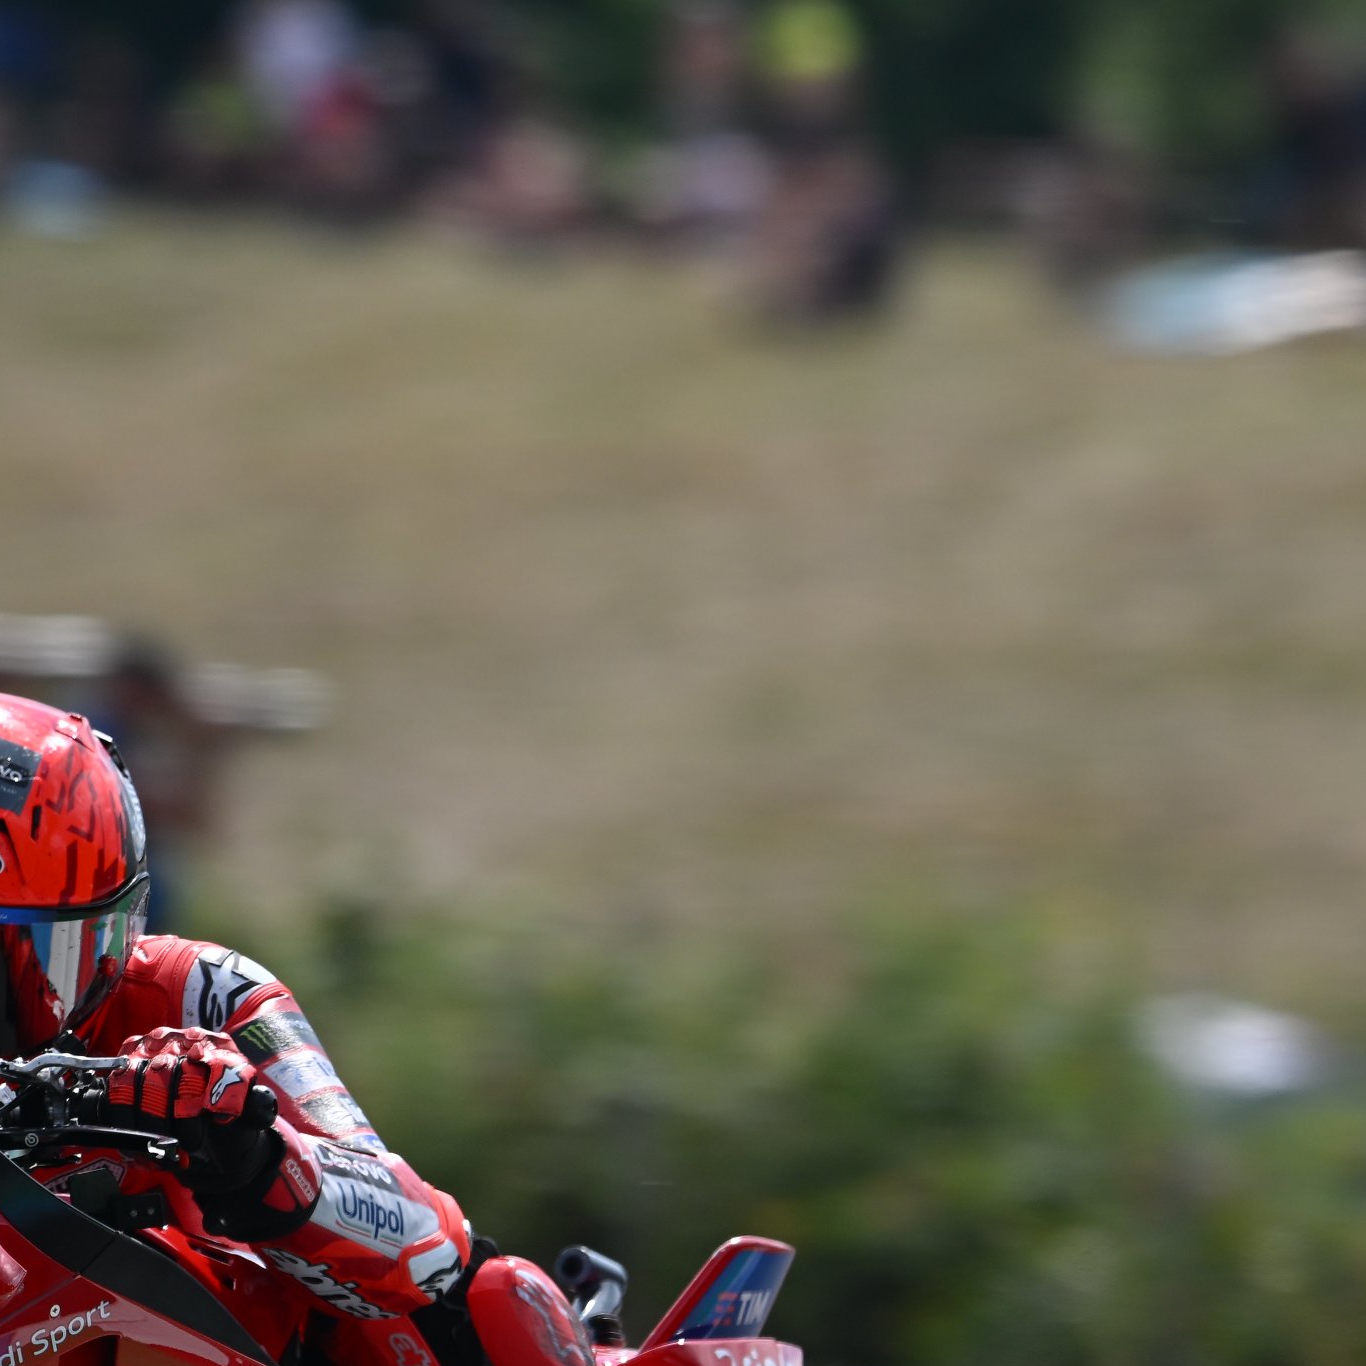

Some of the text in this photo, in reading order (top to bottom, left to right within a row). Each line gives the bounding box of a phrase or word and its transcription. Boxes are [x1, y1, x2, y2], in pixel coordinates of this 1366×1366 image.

[315, 1144, 393, 1185] Lenovo
[338, 1182, 404, 1240] Unipol
[31, 1300, 112, 1356] Sport
[736, 1291, 772, 1326] TIM
